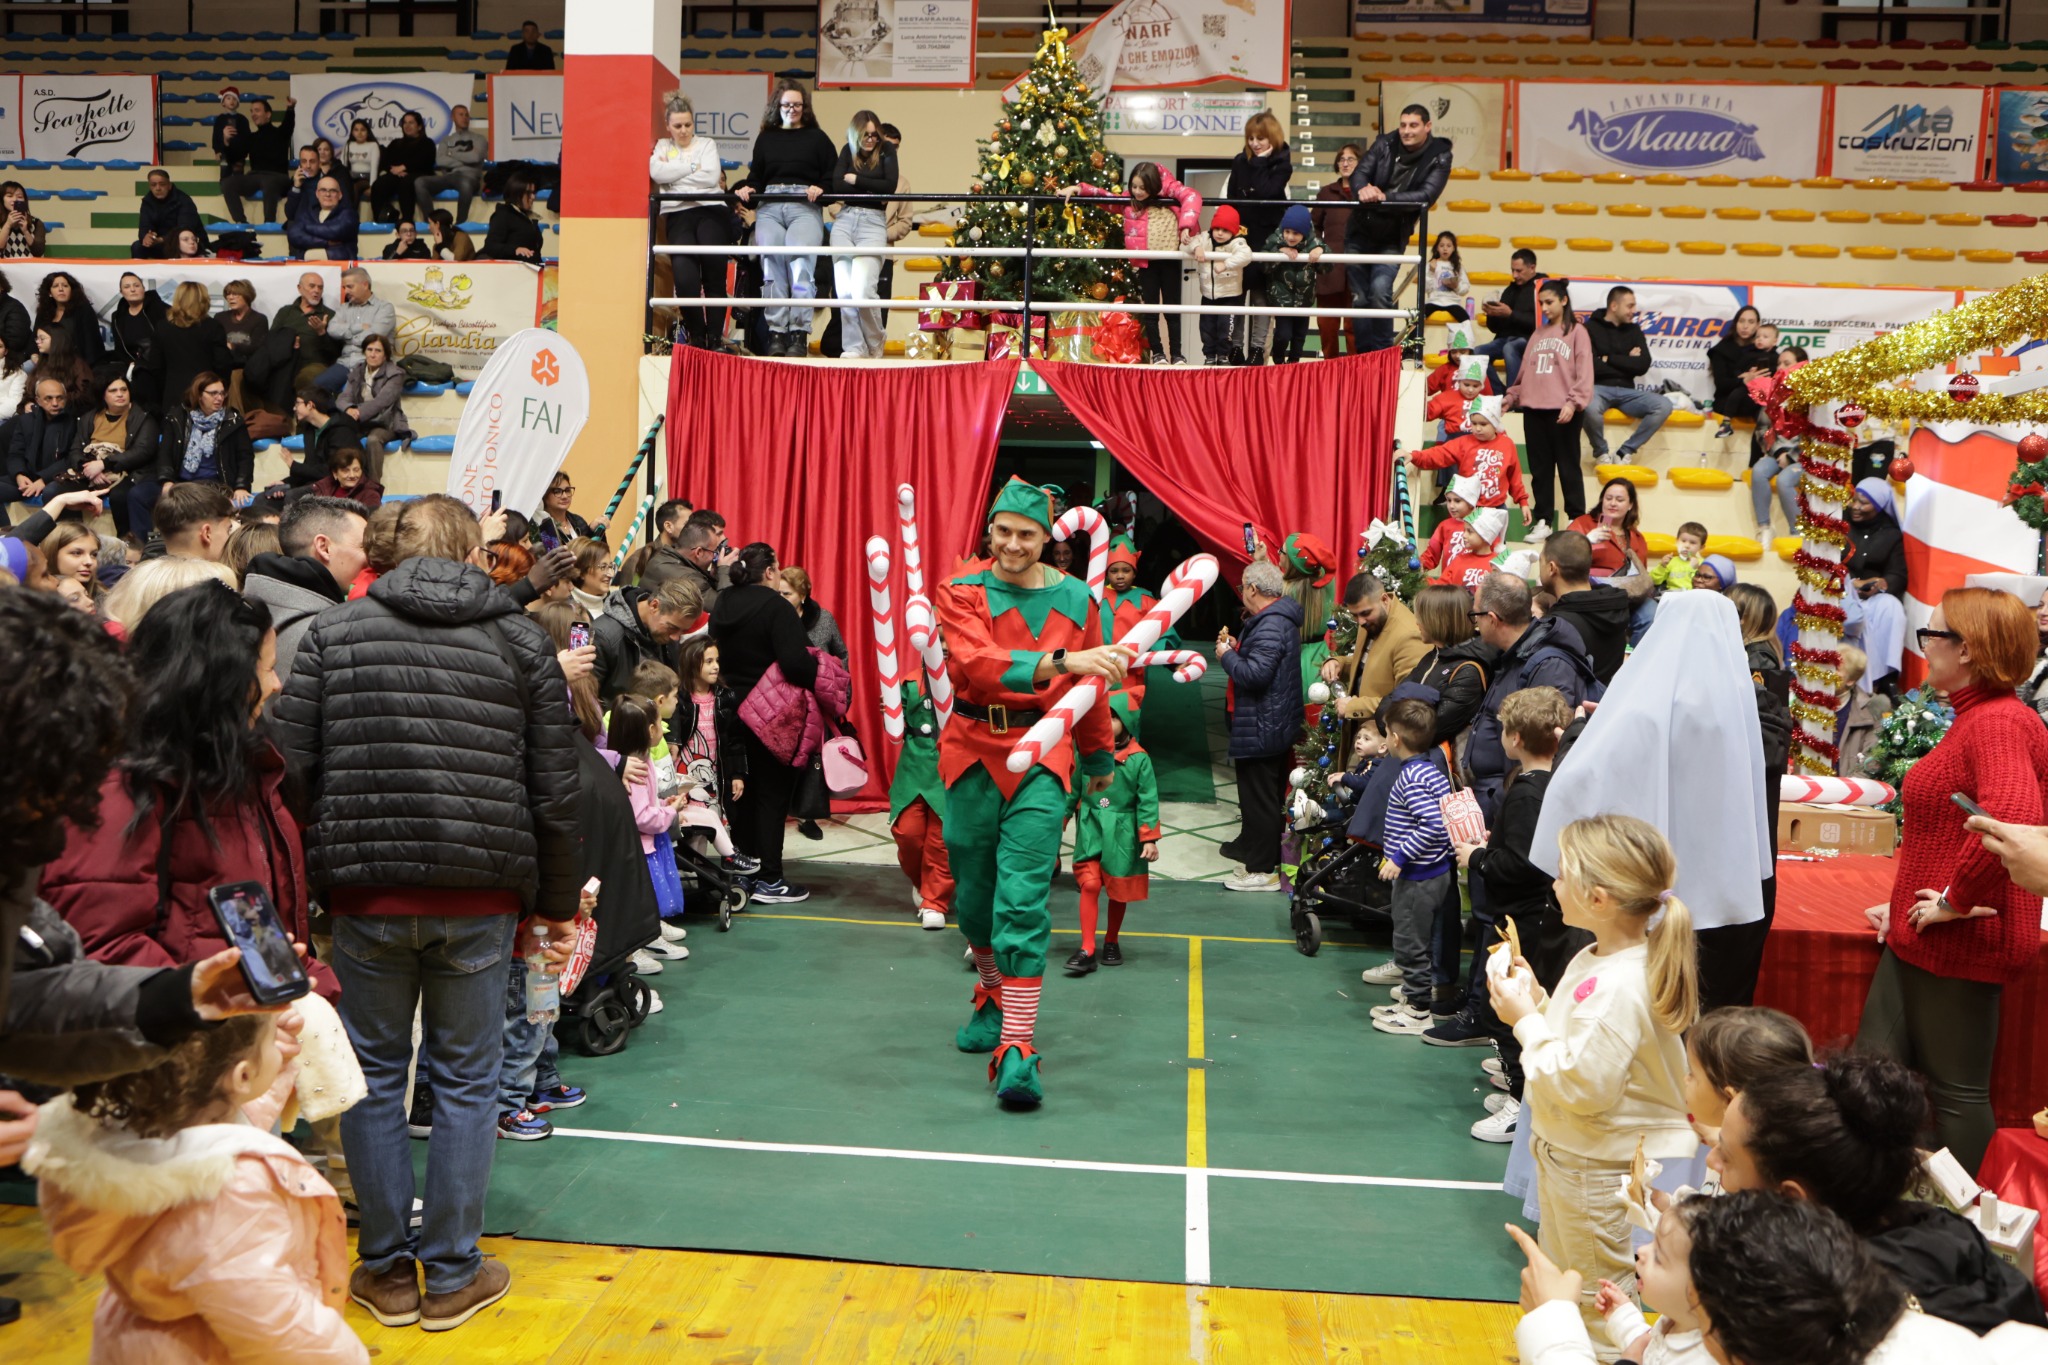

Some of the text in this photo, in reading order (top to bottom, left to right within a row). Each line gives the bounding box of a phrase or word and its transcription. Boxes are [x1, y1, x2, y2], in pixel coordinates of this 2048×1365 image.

[1128, 50, 1148, 64] CHE
[34, 89, 55, 97] A.S.D.
[1609, 92, 1733, 113] LAVANDERIA
[34, 94, 135, 135] Scarpette
[1162, 115, 1242, 131] DONNE
[1861, 103, 1954, 133] Akta
[75, 120, 135, 143] Rosa
[1599, 115, 1737, 152] Maura
[1838, 134, 1974, 152] costruzioni
[1762, 318, 1805, 327] PIZZERIA
[1813, 320, 1876, 329] ROSTICCERIA
[394, 315, 498, 357] Claudia
[1649, 338, 1712, 350] FFICINA
[1779, 336, 1826, 348] ADE
[1536, 353, 1554, 374] DC
[521, 397, 562, 434] FAI
[484, 393, 503, 470] JONICO
